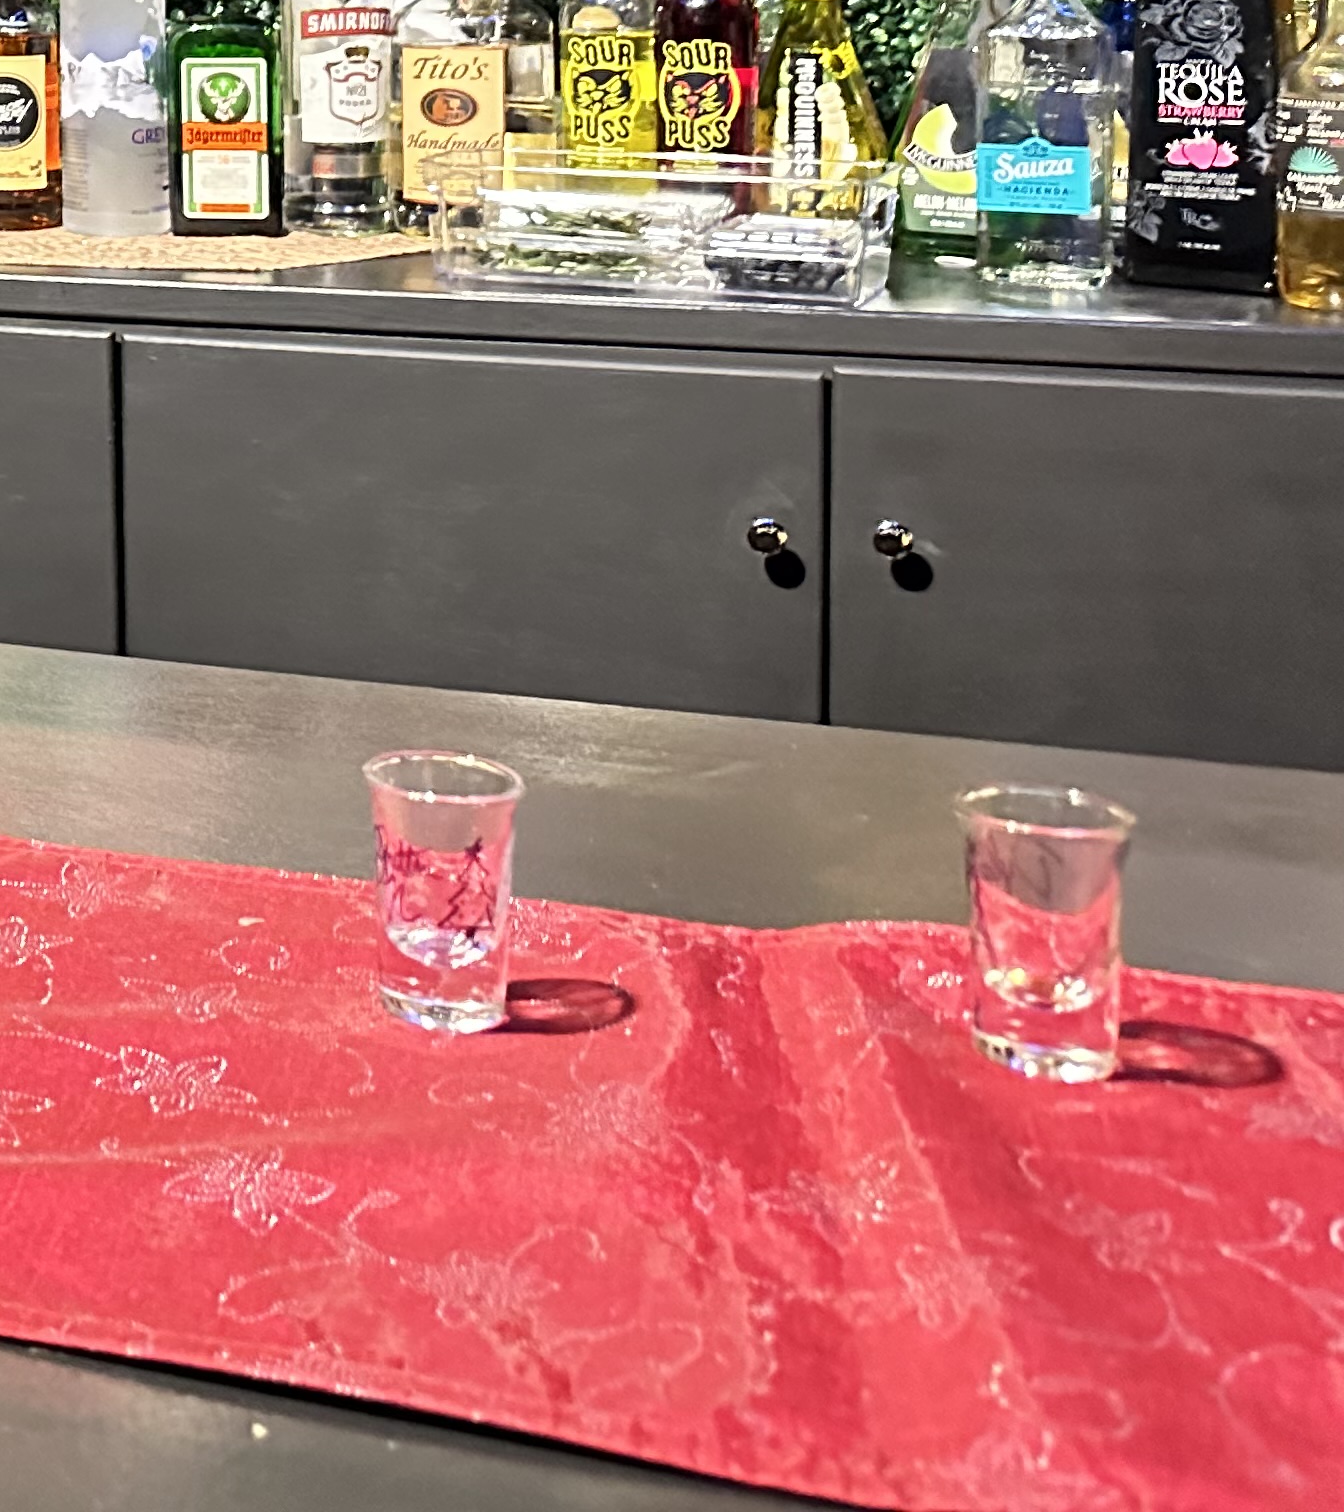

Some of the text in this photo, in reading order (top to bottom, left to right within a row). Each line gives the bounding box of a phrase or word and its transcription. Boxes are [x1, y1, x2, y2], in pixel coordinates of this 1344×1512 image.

[412, 55, 490, 81] Tito's
[570, 38, 632, 68] SOUR
[665, 42, 729, 71] SOUR
[1155, 63, 1243, 82] TEQUILA
[1157, 77, 1246, 108] ROSE
[573, 114, 632, 144] PUSS
[668, 118, 728, 149] PUSS
[993, 151, 1075, 184] Sauza
